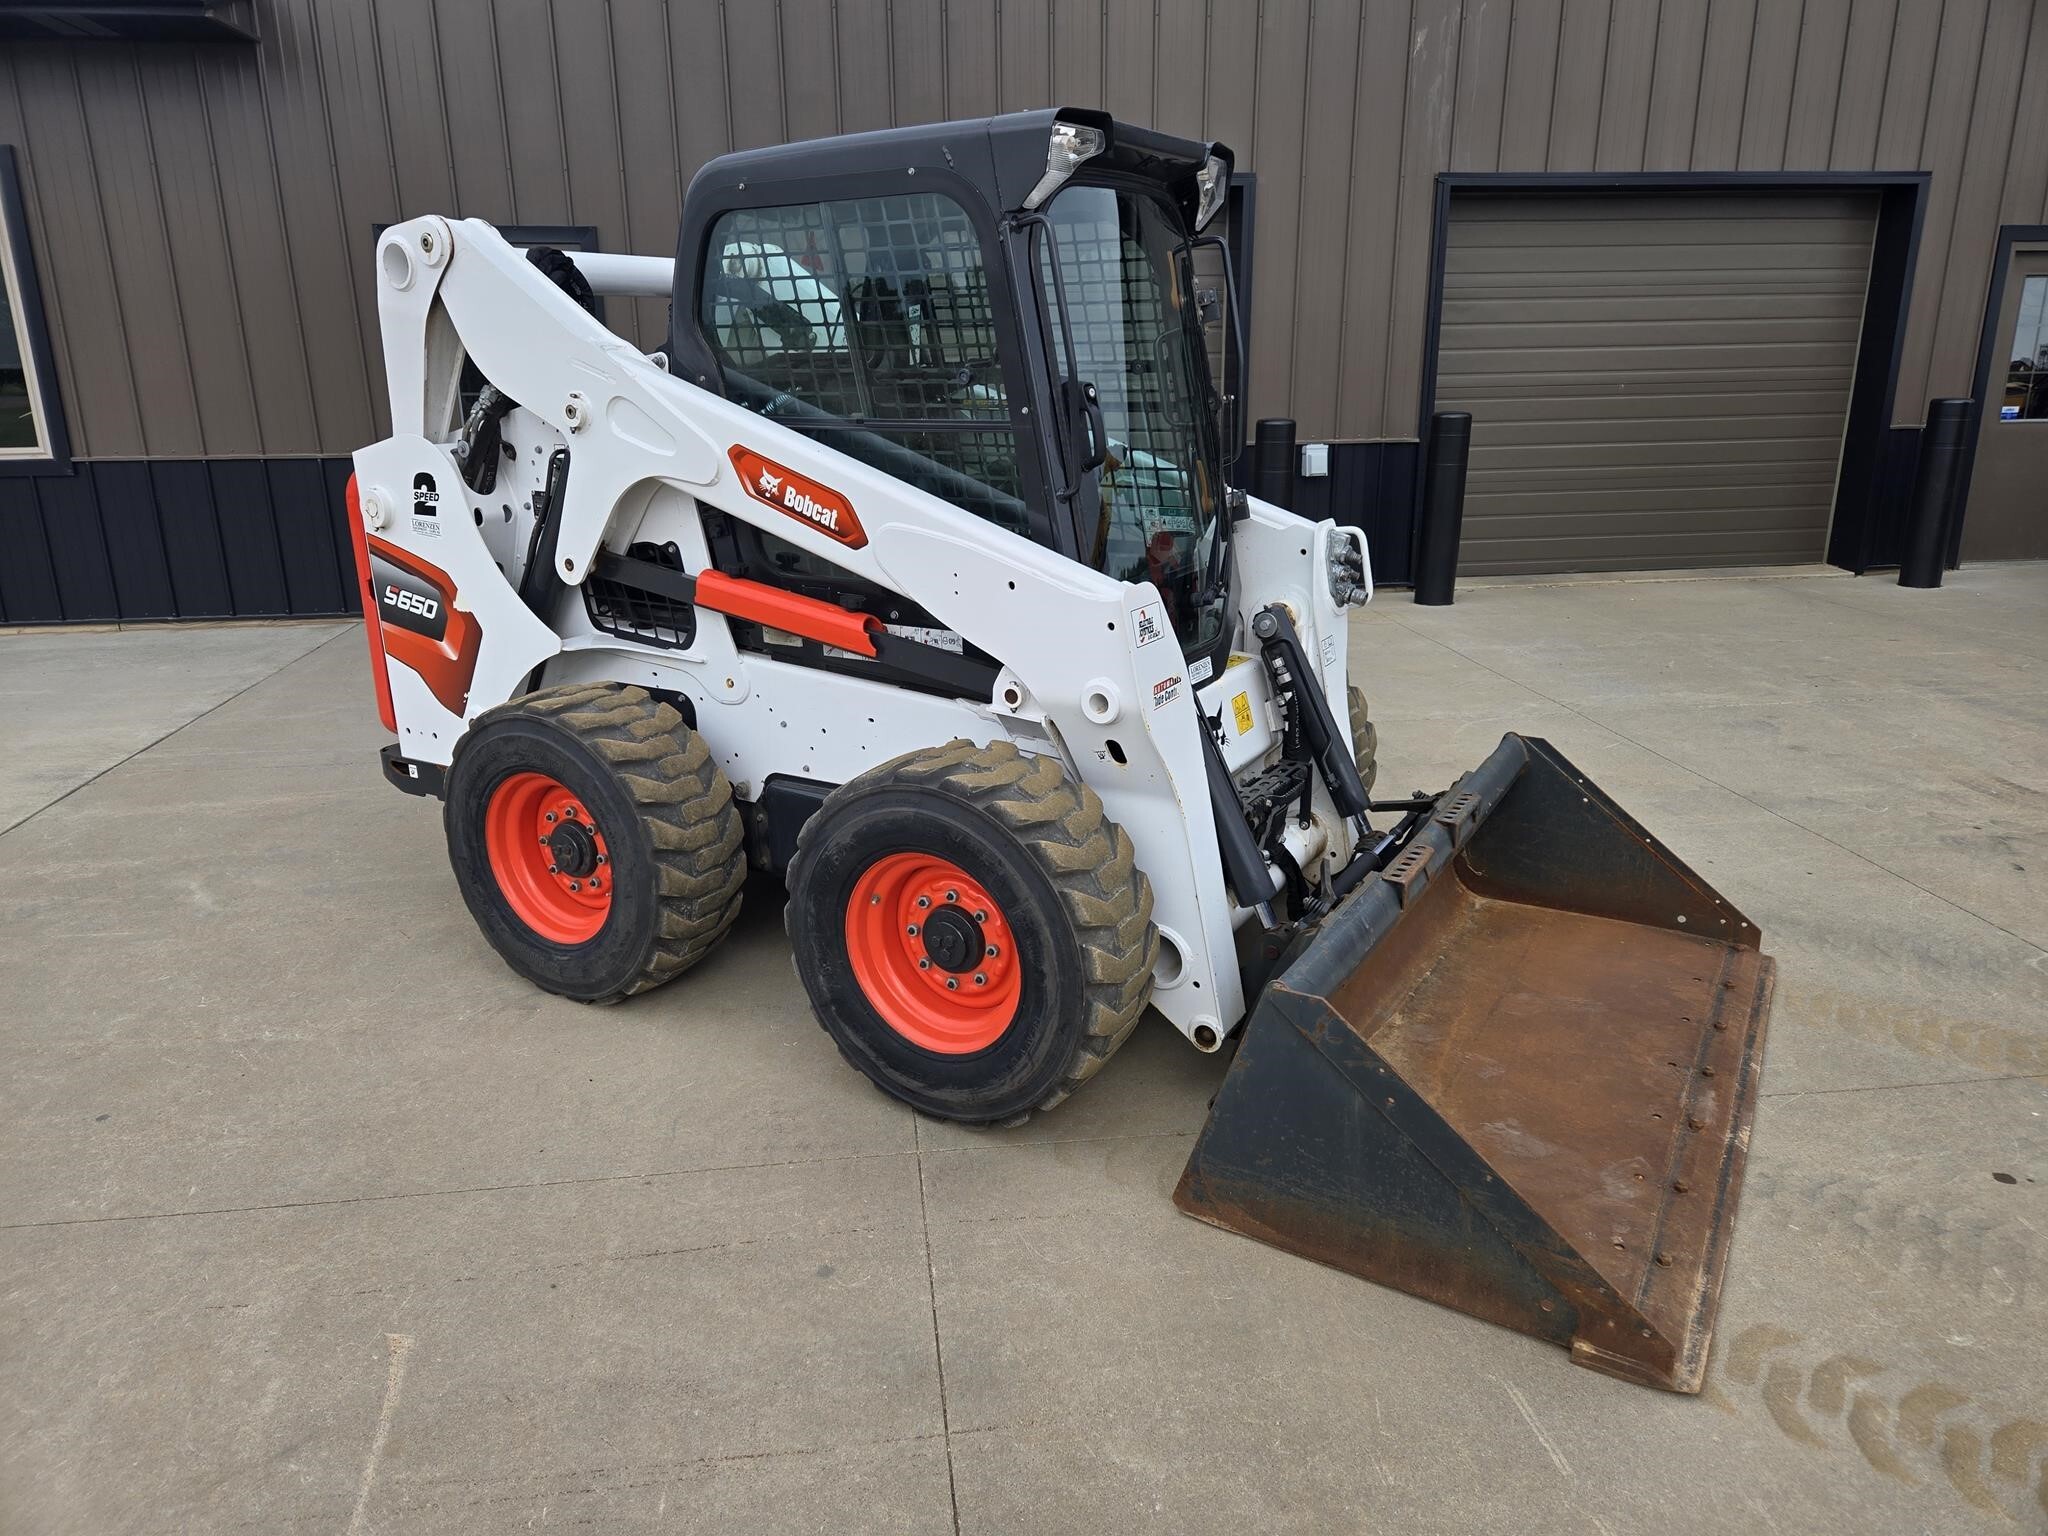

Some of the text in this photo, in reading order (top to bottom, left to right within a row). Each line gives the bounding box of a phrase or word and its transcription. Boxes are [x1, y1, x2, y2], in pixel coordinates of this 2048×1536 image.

[413, 471, 437, 517] 2
[413, 491, 440, 502] SPEED
[783, 485, 838, 531] Bobcat
[383, 584, 439, 620] S650
